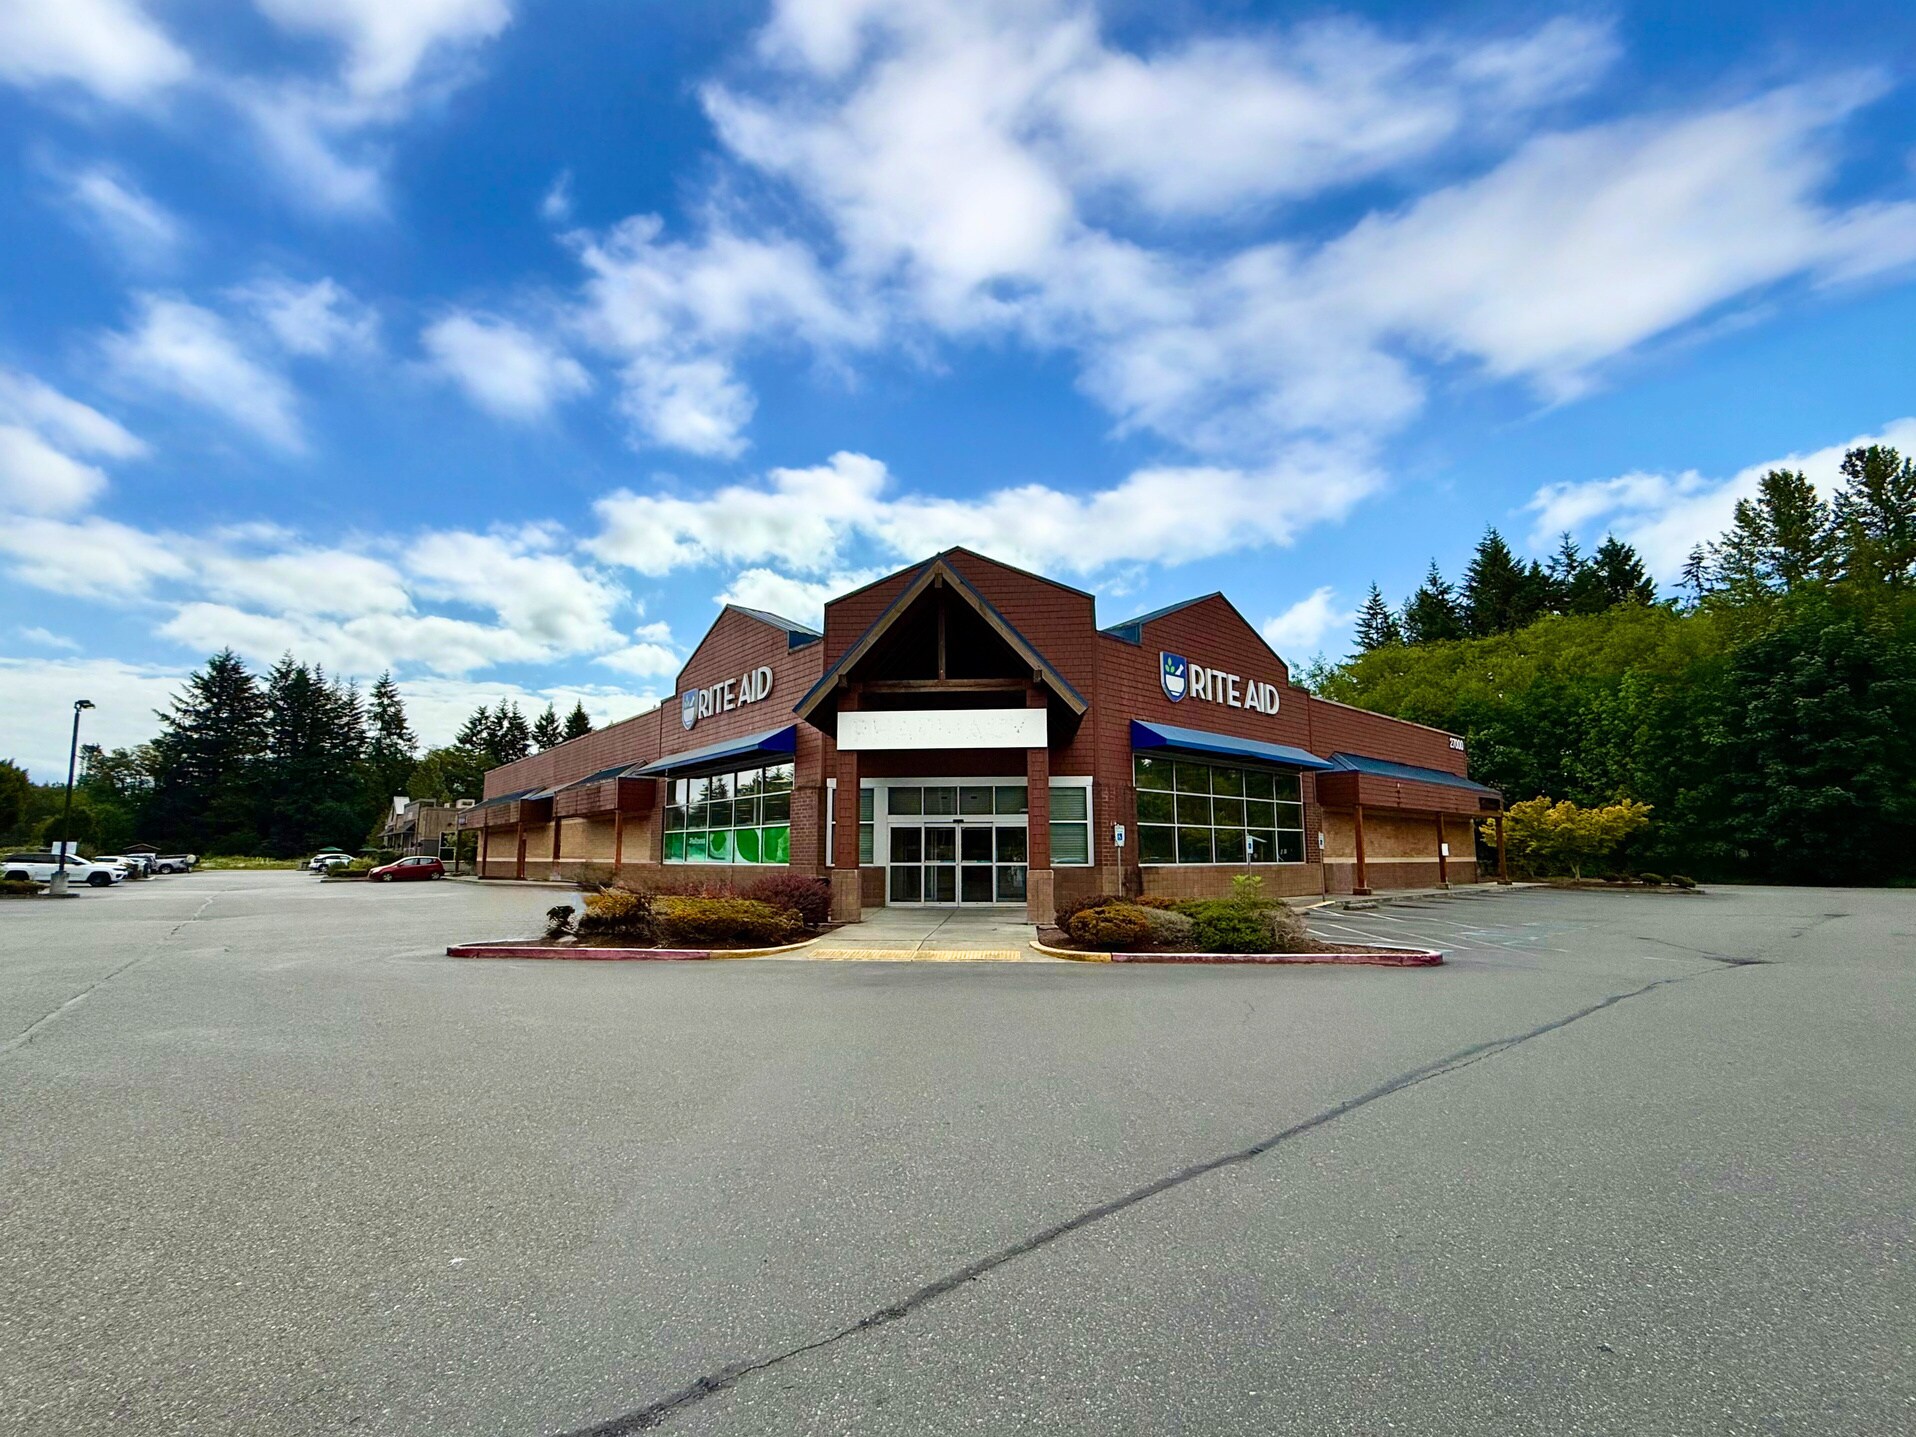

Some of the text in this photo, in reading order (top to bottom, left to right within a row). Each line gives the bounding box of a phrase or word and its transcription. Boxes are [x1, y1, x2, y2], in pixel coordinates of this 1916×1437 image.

[698, 666, 773, 719] RITE AID
[1188, 663, 1280, 715] RITE AID
